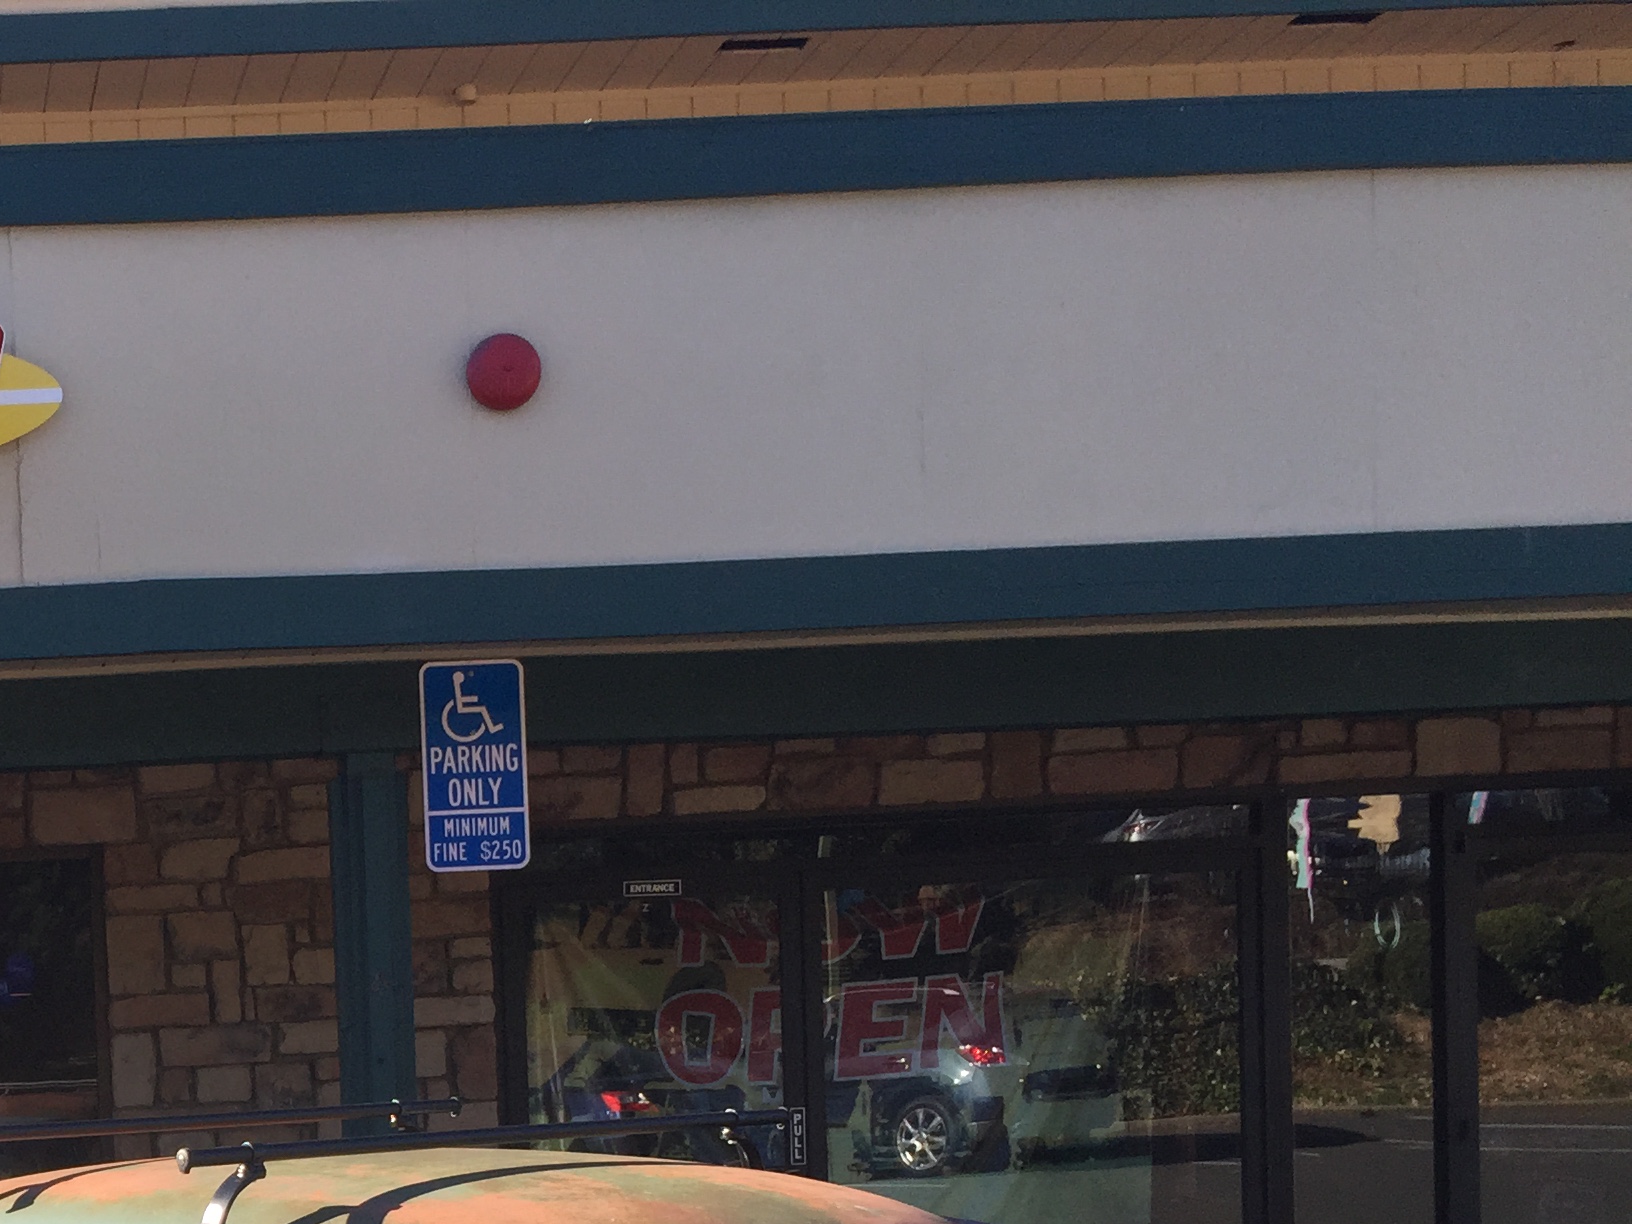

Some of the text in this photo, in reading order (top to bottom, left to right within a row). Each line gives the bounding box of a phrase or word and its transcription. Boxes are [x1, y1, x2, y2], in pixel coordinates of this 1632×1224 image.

[429, 742, 519, 775] PARKING
[448, 776, 503, 808] ONLY
[443, 815, 511, 838] MINIMUM
[433, 838, 523, 863] FINE $250
[629, 882, 675, 893] ENTRANCE
[793, 1112, 803, 1160] PULL
